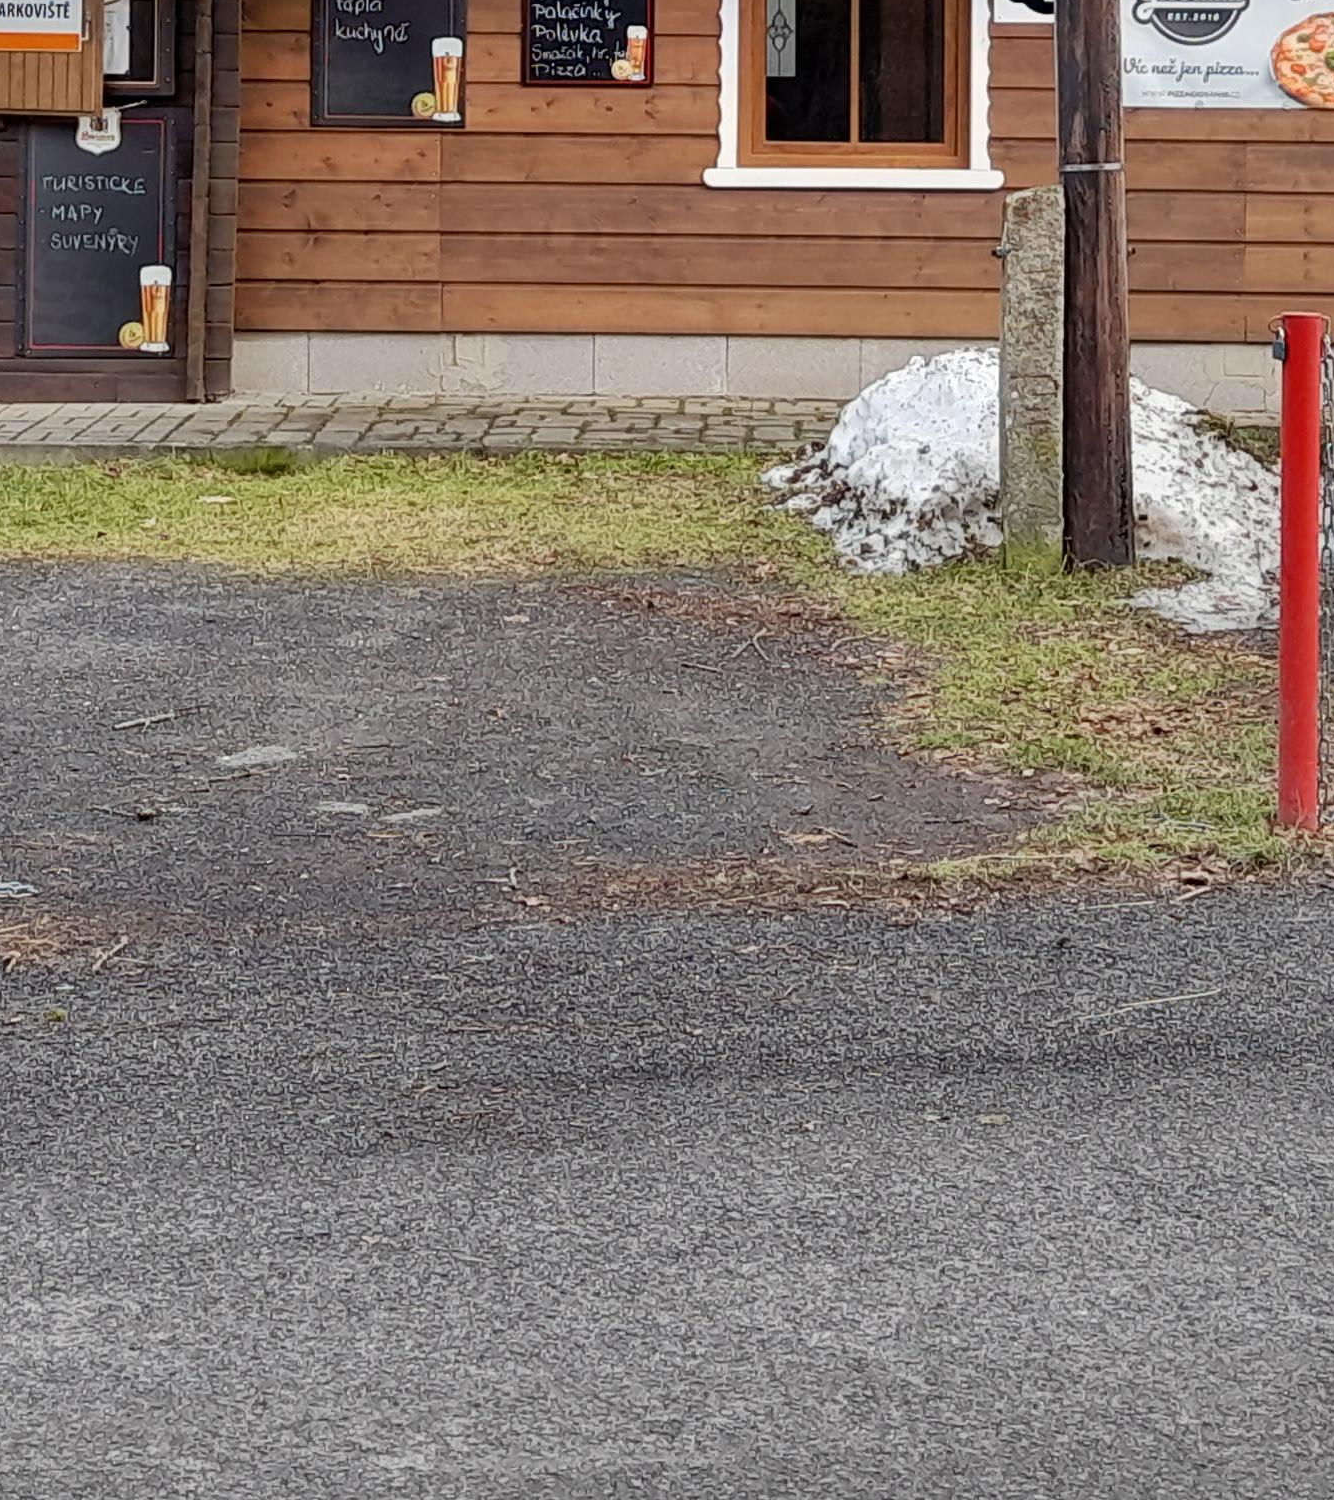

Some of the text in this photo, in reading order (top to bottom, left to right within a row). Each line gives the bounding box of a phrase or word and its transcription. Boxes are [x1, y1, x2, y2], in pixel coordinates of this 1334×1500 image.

[1124, 57, 1149, 74] Víc
[1151, 58, 1178, 75] než
[1176, 61, 1203, 83] jen
[51, 204, 103, 225] MAPY
